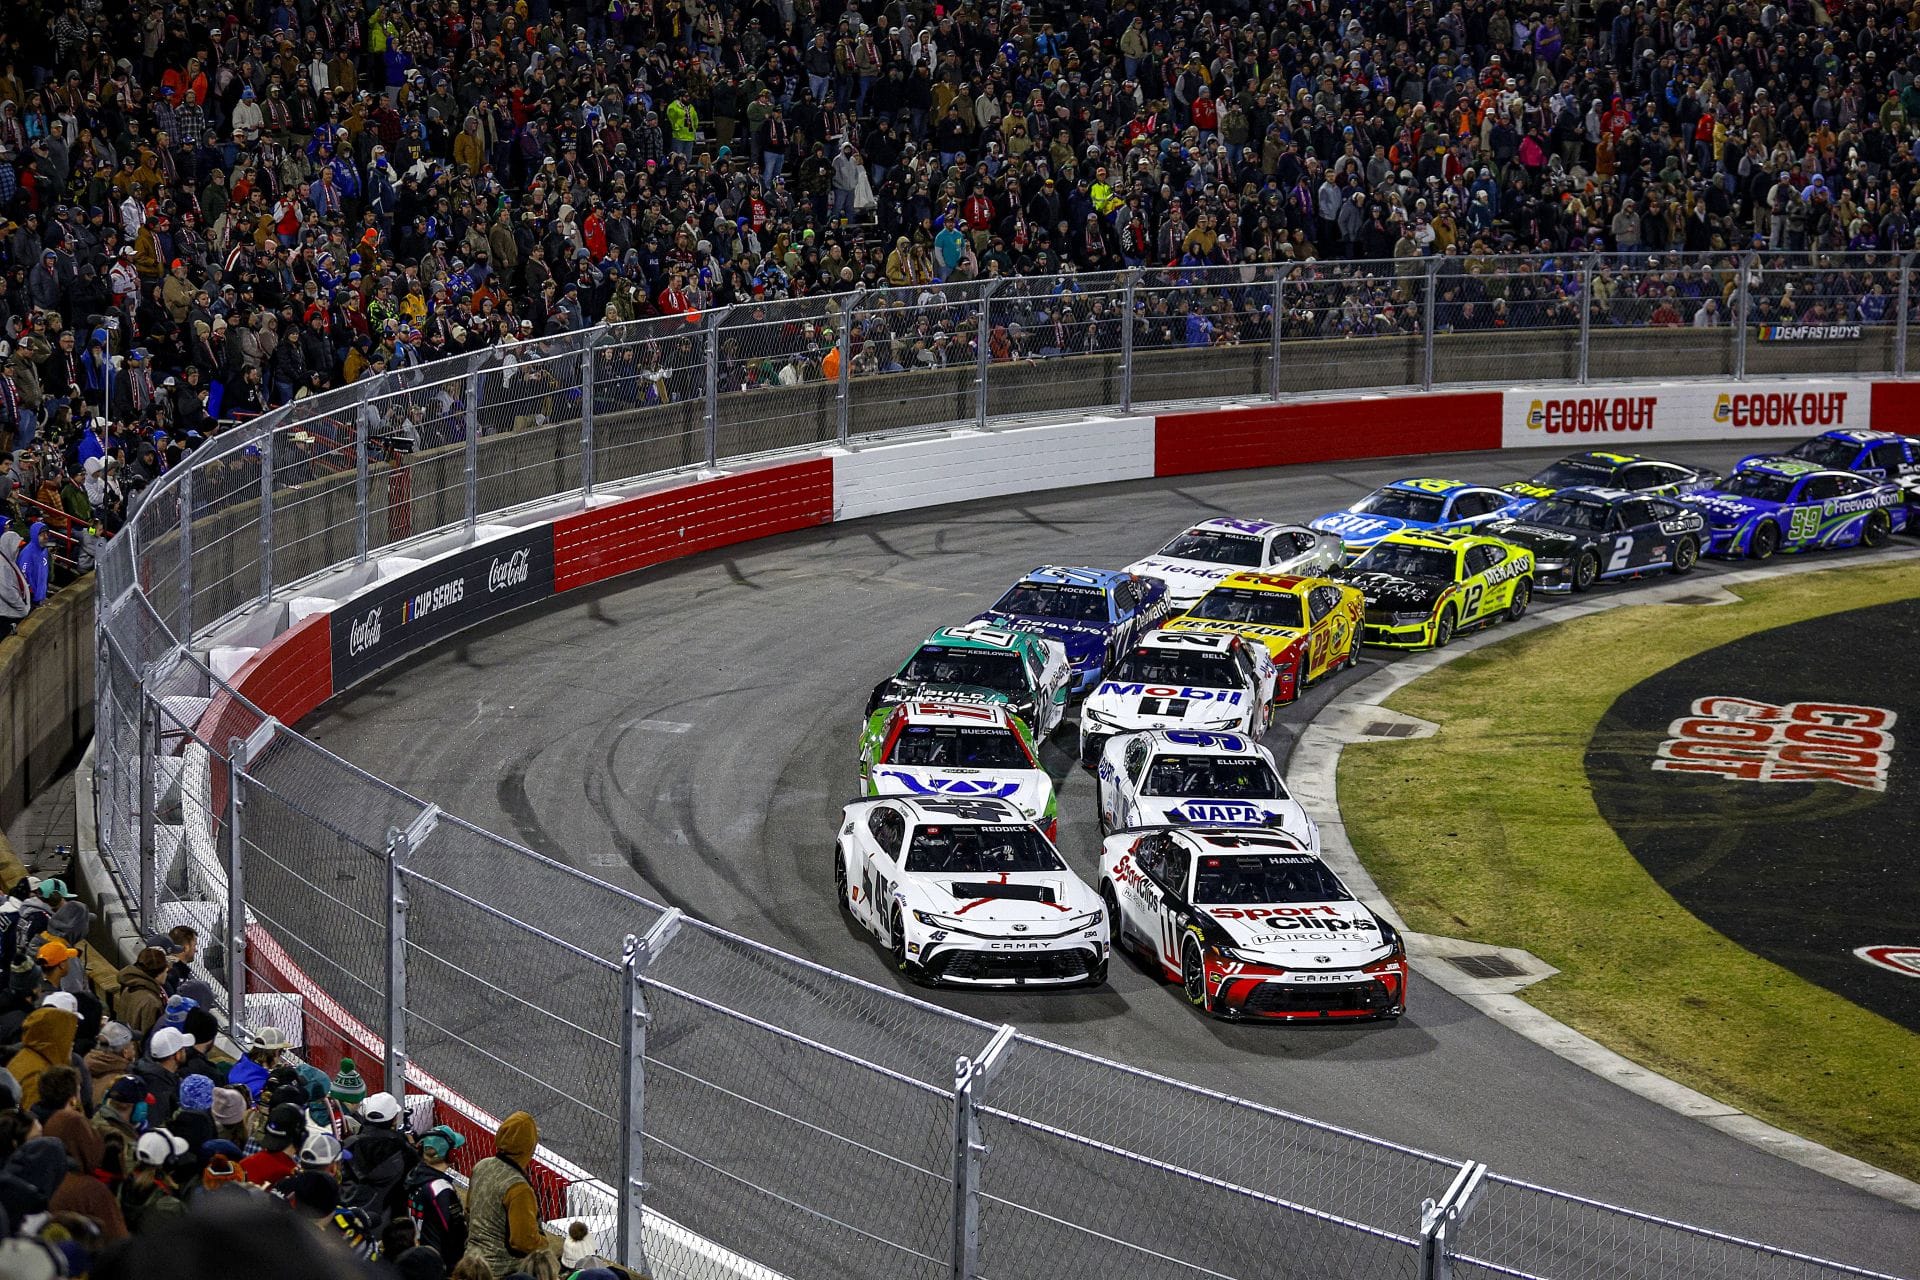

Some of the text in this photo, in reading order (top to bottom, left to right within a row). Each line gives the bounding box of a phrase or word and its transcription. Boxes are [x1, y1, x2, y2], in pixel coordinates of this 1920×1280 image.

[1544, 397, 1657, 433] COOK OUT
[1732, 391, 1847, 427] COOK OUT
[1788, 505, 1824, 540] 99
[1607, 536, 1634, 571] 2
[489, 547, 530, 593] Coca-Cola
[414, 577, 464, 619] CUP SERIES
[1462, 584, 1483, 620] 12
[350, 606, 383, 656] Coca-Cola
[1170, 620, 1297, 638] PENNZOIL
[967, 649, 1017, 657] KESELOWSKI
[1311, 628, 1331, 671] 22
[1098, 683, 1242, 705] Mobil
[1153, 698, 1166, 715] 1
[961, 728, 1011, 736] BUESCHER
[1188, 806, 1261, 822] NAPA
[981, 825, 1026, 833] REDDICK
[1269, 856, 1313, 864] HAMLIN
[1210, 905, 1341, 919] Sport
[1266, 916, 1377, 932] Clips
[928, 930, 949, 942] 45
[1257, 932, 1365, 942] HAIRCUTS
[1227, 961, 1245, 974] 11
[1294, 974, 1355, 982] CAMRY
